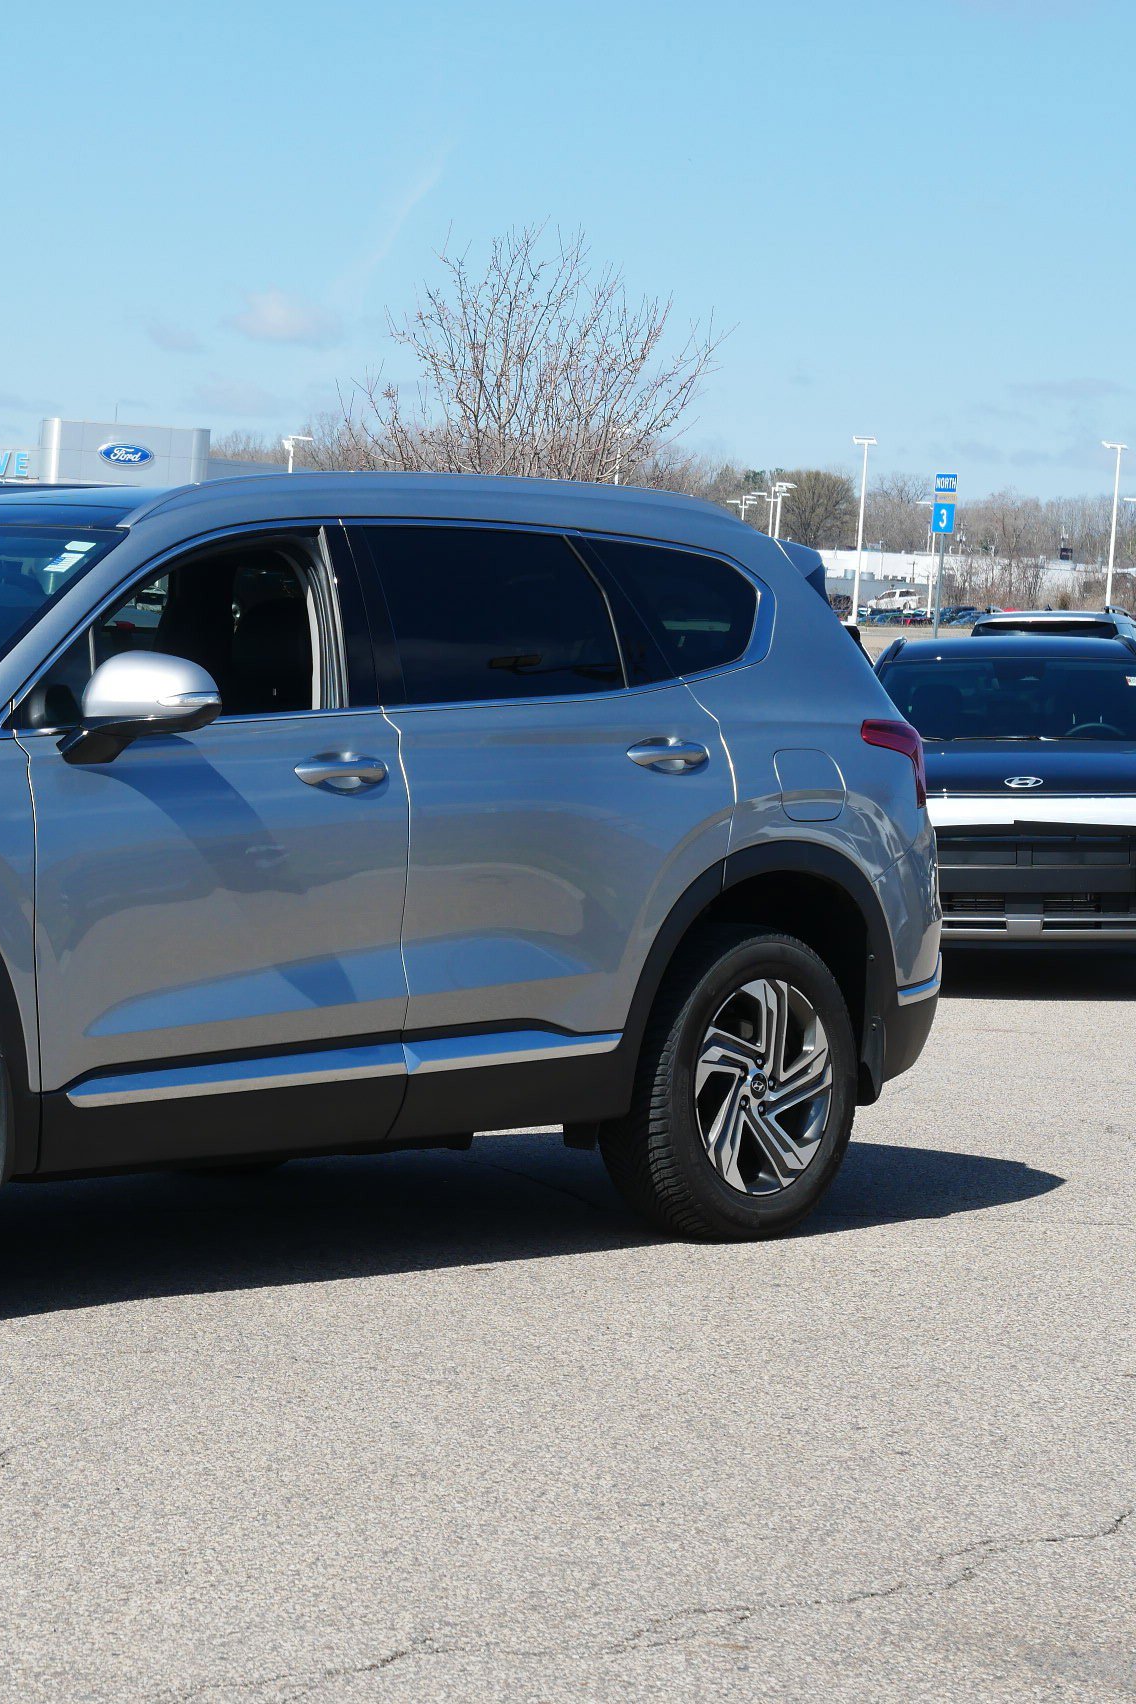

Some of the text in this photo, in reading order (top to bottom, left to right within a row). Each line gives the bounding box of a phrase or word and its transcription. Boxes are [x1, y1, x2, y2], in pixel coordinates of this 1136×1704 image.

[110, 447, 142, 461] Ford
[936, 477, 957, 489] NORTH
[939, 508, 947, 529] 3
